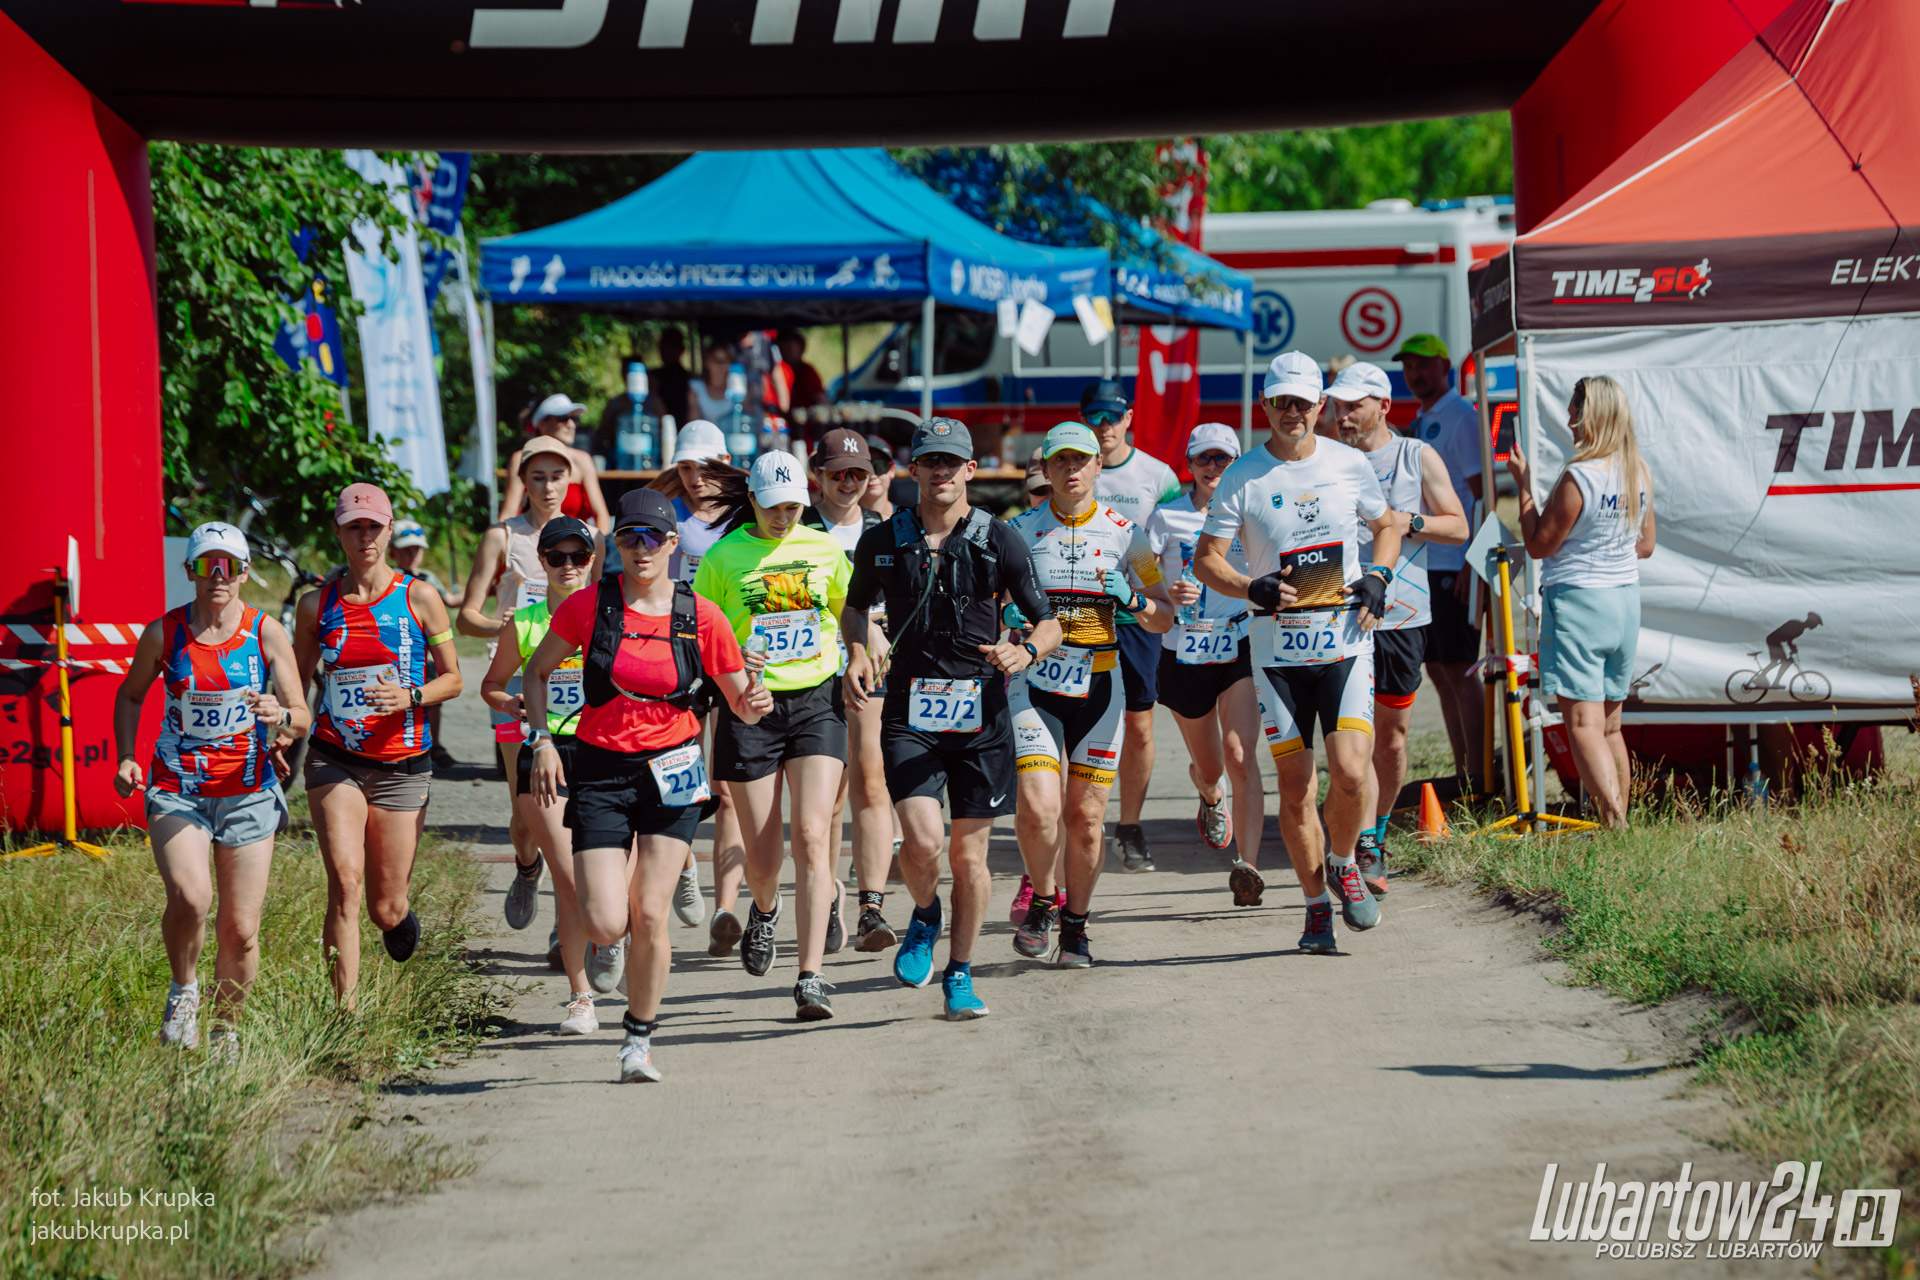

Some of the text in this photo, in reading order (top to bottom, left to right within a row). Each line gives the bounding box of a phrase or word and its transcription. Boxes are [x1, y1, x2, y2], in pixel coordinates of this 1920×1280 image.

[748, 264, 816, 287] SPORT
[1830, 255, 1920, 285] ELEK
[1552, 267, 1700, 303] TIME2GO
[1359, 302, 1386, 337] S
[775, 466, 791, 482] NY
[1297, 551, 1328, 566] POL
[765, 629, 814, 651] 25/2
[1185, 635, 1232, 653] 24/2
[1282, 631, 1336, 650] 20/2
[1036, 660, 1083, 684] 20/1
[340, 687, 368, 708] 28
[551, 686, 579, 704] 25
[192, 705, 246, 727] 28/2
[920, 698, 975, 720] 22/2
[667, 766, 704, 794] 22/
